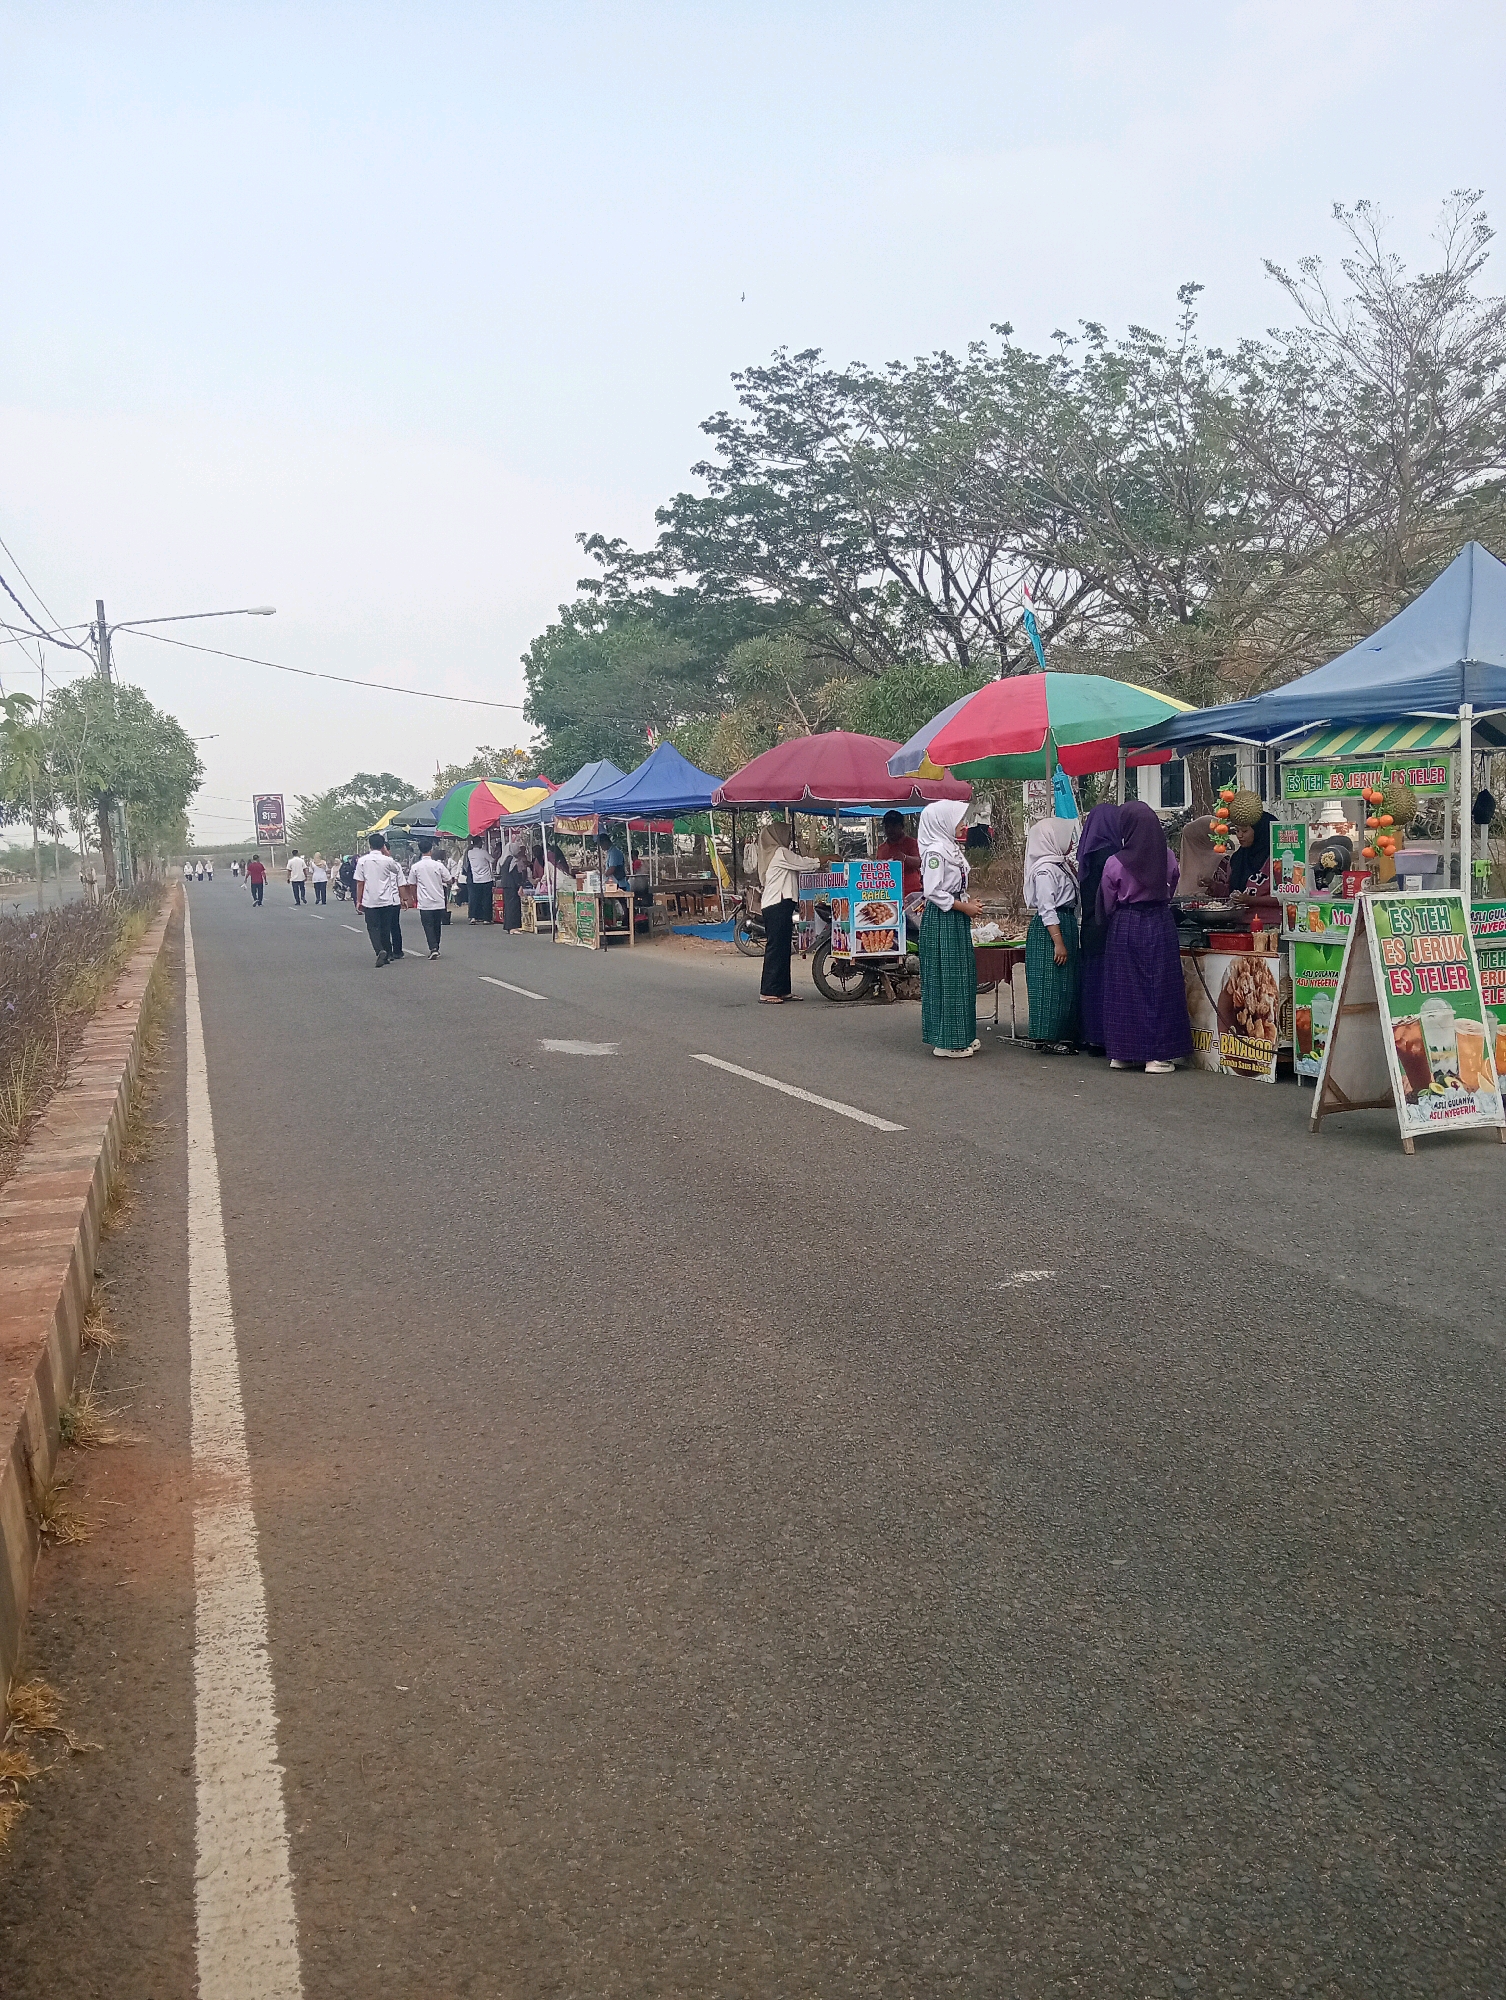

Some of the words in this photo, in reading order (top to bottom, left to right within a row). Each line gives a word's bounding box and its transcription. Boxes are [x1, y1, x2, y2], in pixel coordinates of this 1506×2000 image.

[1287, 775, 1300, 792] ES
[1302, 774, 1323, 791] TEH
[1330, 773, 1344, 790] ES
[1409, 767, 1446, 786] TELER
[861, 863, 890, 872] CILOR
[860, 871, 891, 880] TELOR
[855, 880, 896, 890] GULUNG
[861, 889, 891, 900] RAHEL
[1389, 907, 1414, 935] ES
[1414, 905, 1452, 934] TEH
[1381, 937, 1407, 966] ES
[1410, 934, 1468, 964] JERUK
[1389, 967, 1414, 996] ES
[1414, 964, 1471, 994] TELER
[1480, 970, 1506, 987] ERU
[1481, 988, 1506, 1005] ELE
[1433, 1101, 1447, 1110] ASLI
[1447, 1096, 1475, 1108] GULANYA
[1429, 1110, 1443, 1120] ASLI
